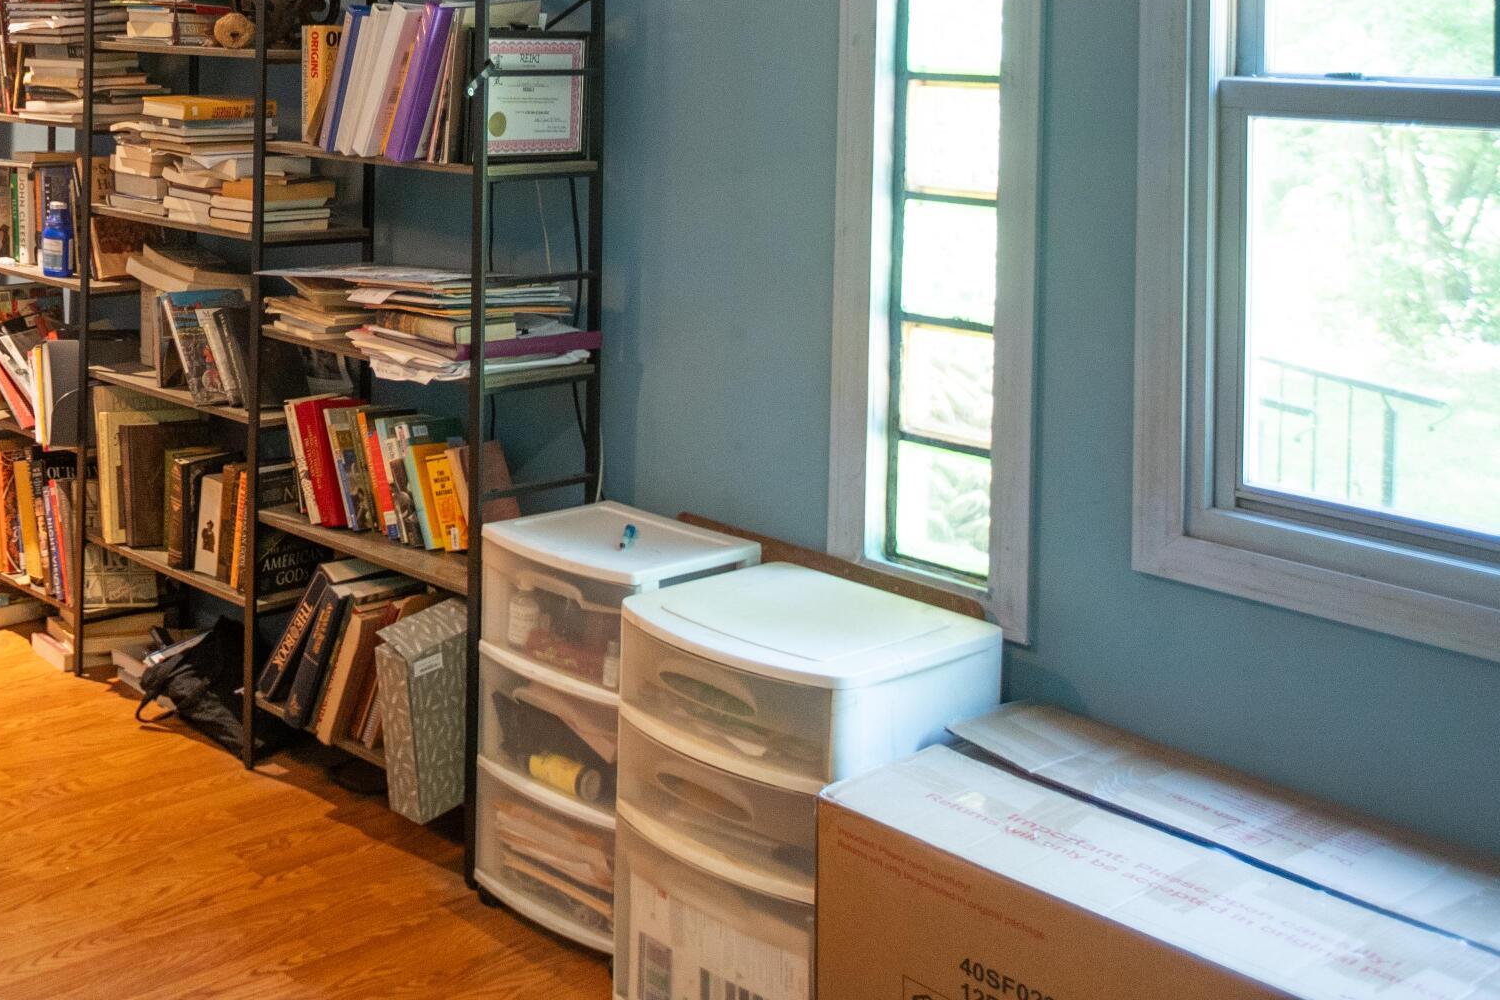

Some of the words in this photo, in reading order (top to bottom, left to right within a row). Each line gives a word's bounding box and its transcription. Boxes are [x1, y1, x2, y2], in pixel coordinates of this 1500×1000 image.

[310, 31, 320, 79] ORIGINS
[520, 53, 540, 64] REIKI
[18, 178, 26, 208] JOHN
[46, 517, 56, 551] NIGHT
[262, 548, 323, 573] AMERICAN
[276, 567, 310, 585] GODS
[293, 601, 314, 632] THE
[272, 633, 297, 672] BOOK
[925, 792, 1000, 827] Returns
[1043, 840, 1086, 861] only
[1091, 858, 1118, 872] be
[1122, 872, 1229, 914] accepted
[1007, 812, 1130, 865] Important:
[1134, 861, 1210, 894] Please
